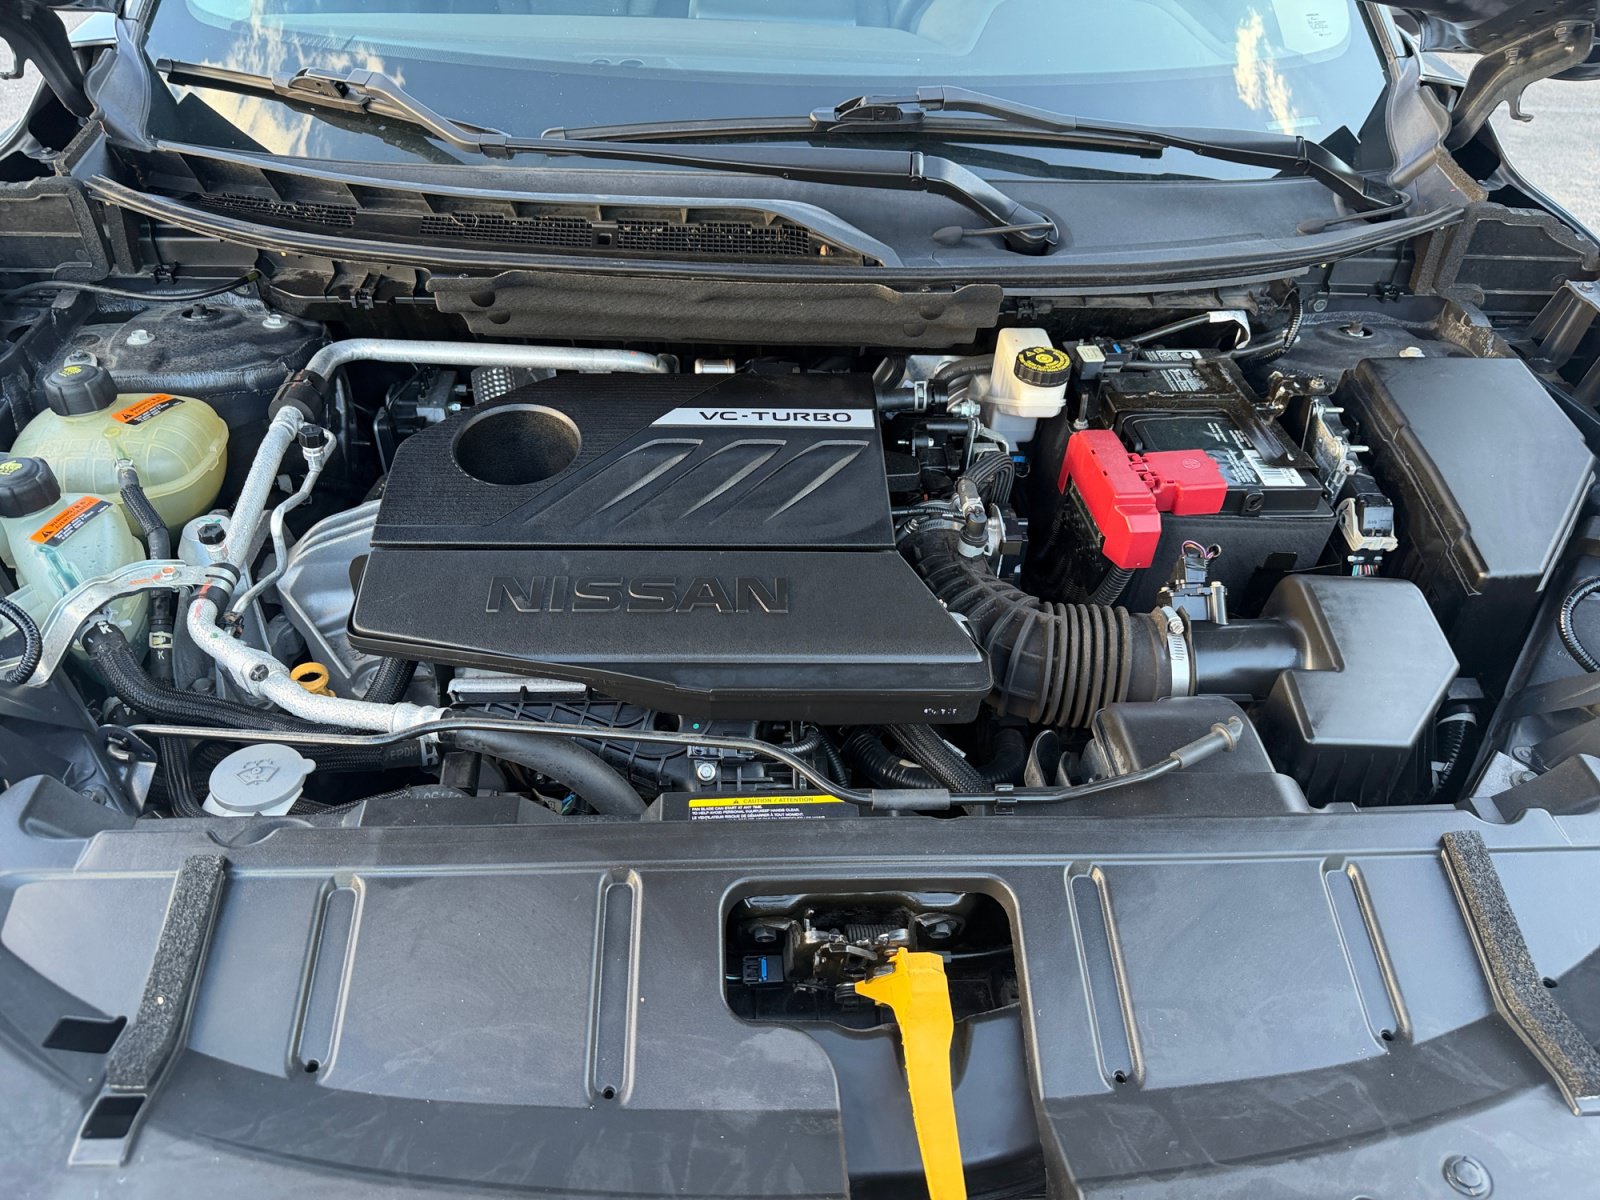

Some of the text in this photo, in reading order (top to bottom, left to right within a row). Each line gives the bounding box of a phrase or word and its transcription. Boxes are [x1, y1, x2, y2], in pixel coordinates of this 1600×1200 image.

[699, 411, 852, 423] VC-TURBO
[486, 576, 789, 613] NISSAN
[157, 650, 164, 660] K
